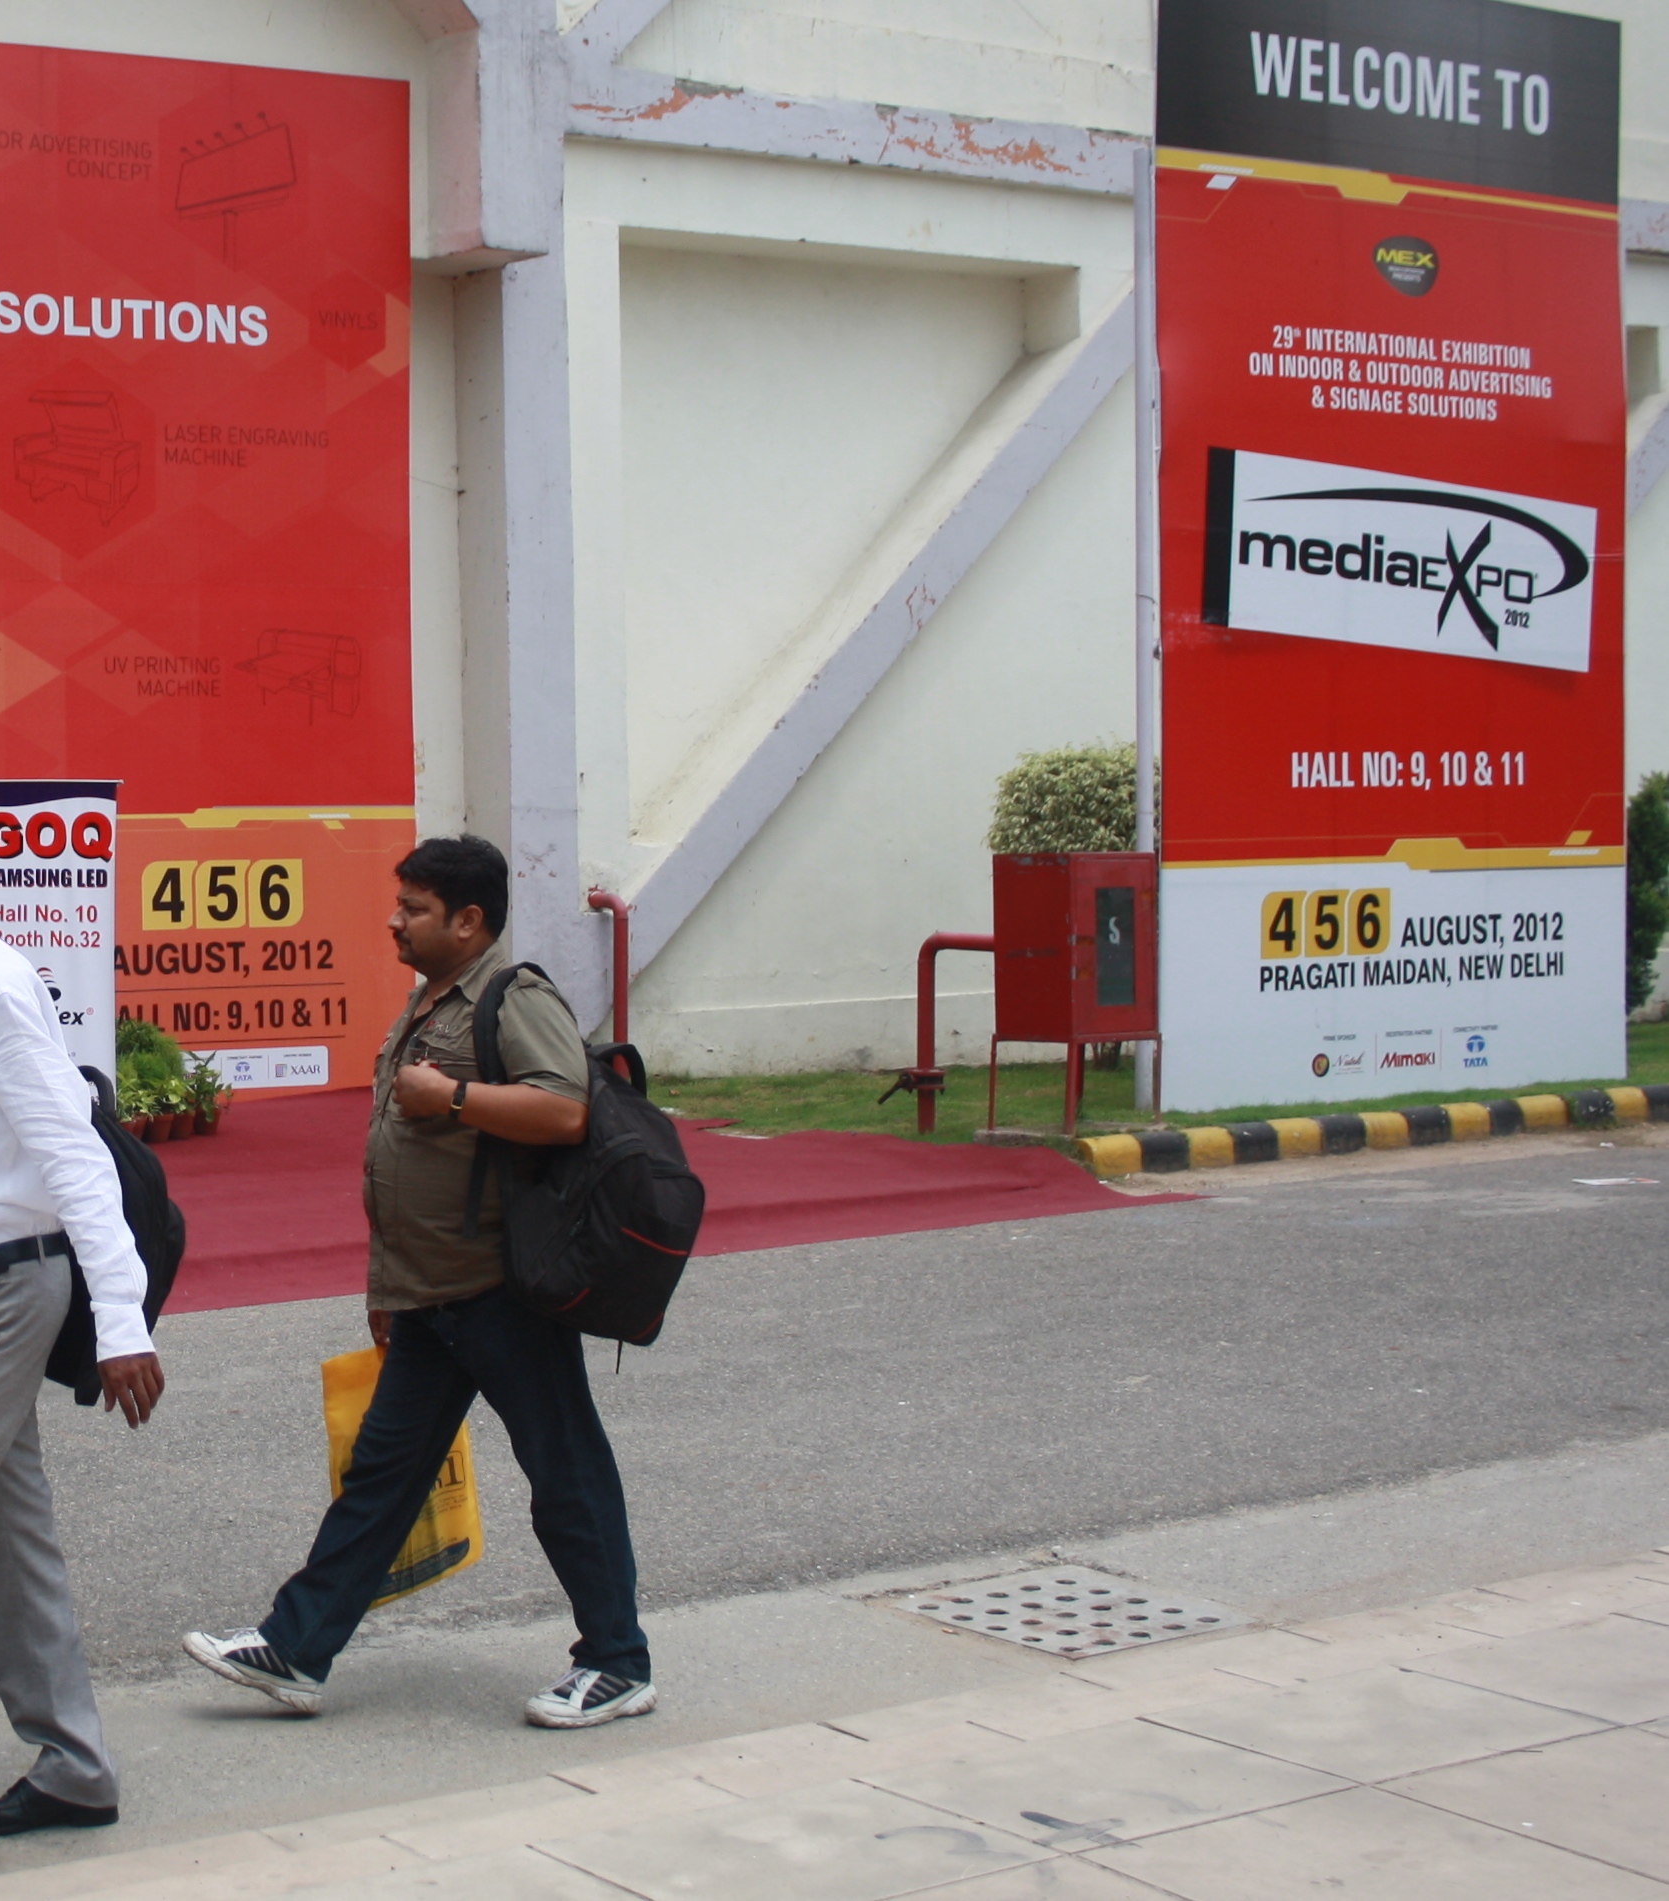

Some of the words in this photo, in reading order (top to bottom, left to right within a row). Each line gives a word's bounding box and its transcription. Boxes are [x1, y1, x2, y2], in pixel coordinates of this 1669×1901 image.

[1250, 30, 1480, 126] WELCOME
[1494, 68, 1550, 136] TO
[30, 133, 153, 160] ADVERTISING
[66, 157, 152, 183] CONCEPT
[1376, 247, 1435, 269] MEX
[318, 309, 378, 332] VINYLS
[1306, 328, 1437, 361] INTERNATIONAL
[1441, 341, 1531, 369] EXHIBITION
[1249, 353, 1273, 376] ON
[1279, 355, 1343, 381] INDOOR
[1348, 364, 1361, 384] &
[1366, 363, 1444, 388] OUTDOOR
[1448, 371, 1552, 399] ADVERTISING
[1311, 386, 1325, 408] &
[1330, 387, 1402, 414] SIGNAGE
[1407, 395, 1498, 421] SOLUTIONS
[164, 424, 221, 444] LASER
[228, 427, 329, 448] ENGRAVING
[164, 448, 247, 468] MACHINE
[1504, 608, 1530, 629] 2012
[104, 655, 129, 675] UV
[134, 656, 220, 675] PRINTING
[137, 679, 221, 697] MACHINE
[1291, 751, 1355, 788] HALL
[1362, 752, 1404, 787] NO:
[1410, 752, 1431, 791] 9,
[1440, 751, 1468, 786] 10
[1474, 752, 1492, 786] &
[1501, 751, 1525, 786] 11
[76, 868, 108, 888] LED
[152, 866, 185, 923] 4
[207, 865, 238, 921] 5
[259, 863, 291, 921] 6
[35, 905, 68, 923] No.
[76, 905, 98, 923] 10
[1269, 896, 1296, 952] 4
[1314, 894, 1340, 950] 5
[1355, 892, 1382, 948] 6
[1400, 913, 1506, 953] AUGUST,
[1513, 911, 1563, 942] 2012
[49, 930, 101, 948] No.32
[115, 941, 250, 979] AUGUST,
[262, 938, 333, 971] 2012
[1260, 962, 1355, 993] PRAGATI
[1363, 957, 1451, 988] MAIDAN,
[1459, 954, 1504, 981] NEW
[1511, 952, 1564, 978] DELHI
[173, 1000, 220, 1032] NO:
[291, 998, 312, 1027] &
[321, 997, 348, 1027] 11
[291, 1064, 321, 1075] XAAR
[1463, 1056, 1489, 1068] TATA
[234, 1074, 253, 1082] TATA
